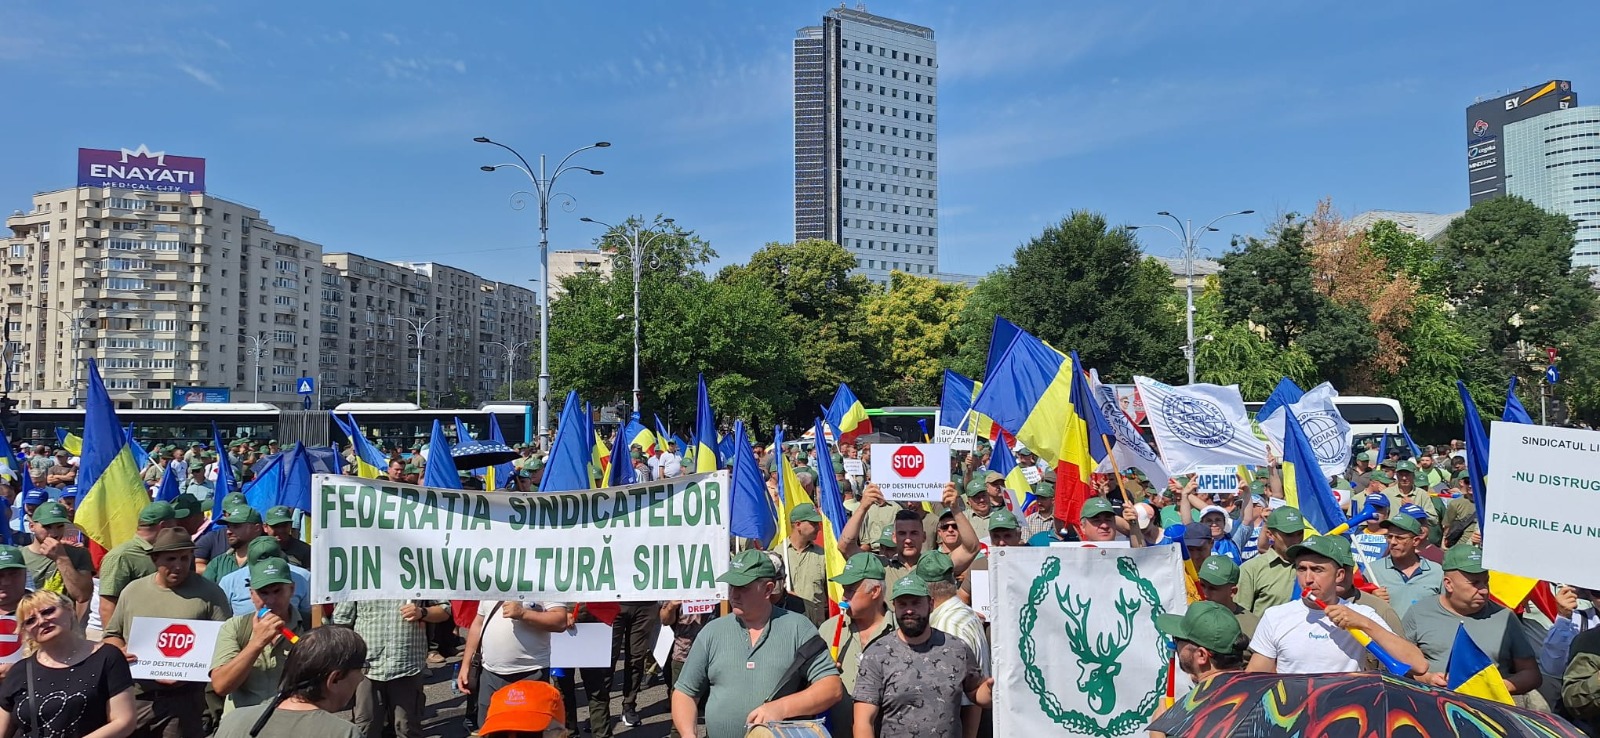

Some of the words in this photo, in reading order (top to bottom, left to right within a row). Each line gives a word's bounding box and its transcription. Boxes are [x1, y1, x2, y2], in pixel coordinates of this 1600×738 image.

[1505, 97, 1519, 110] EY
[1559, 101, 1569, 110] EY
[90, 163, 194, 184] ENAYATI
[102, 181, 152, 191] MEDICAL
[1311, 428, 1338, 447] RIDIAN
[1522, 436, 1587, 451] SINDICATUL
[894, 455, 923, 469] STOP
[1198, 474, 1237, 490] APEHID
[1512, 471, 1535, 483] -NU
[1539, 474, 1600, 491] DISTRUG
[321, 484, 491, 546] FEDERAȚIA
[509, 481, 721, 531] SINDICATELOR
[1492, 512, 1559, 531] PĂDURILE
[1562, 523, 1582, 535] AU
[329, 545, 381, 592] DIN
[400, 534, 616, 592] SILVICULTURĂ
[632, 543, 716, 591] SILVA
[688, 604, 716, 613] DREPT
[158, 632, 194, 650] STOP
[149, 670, 183, 678] ROMSILVA
